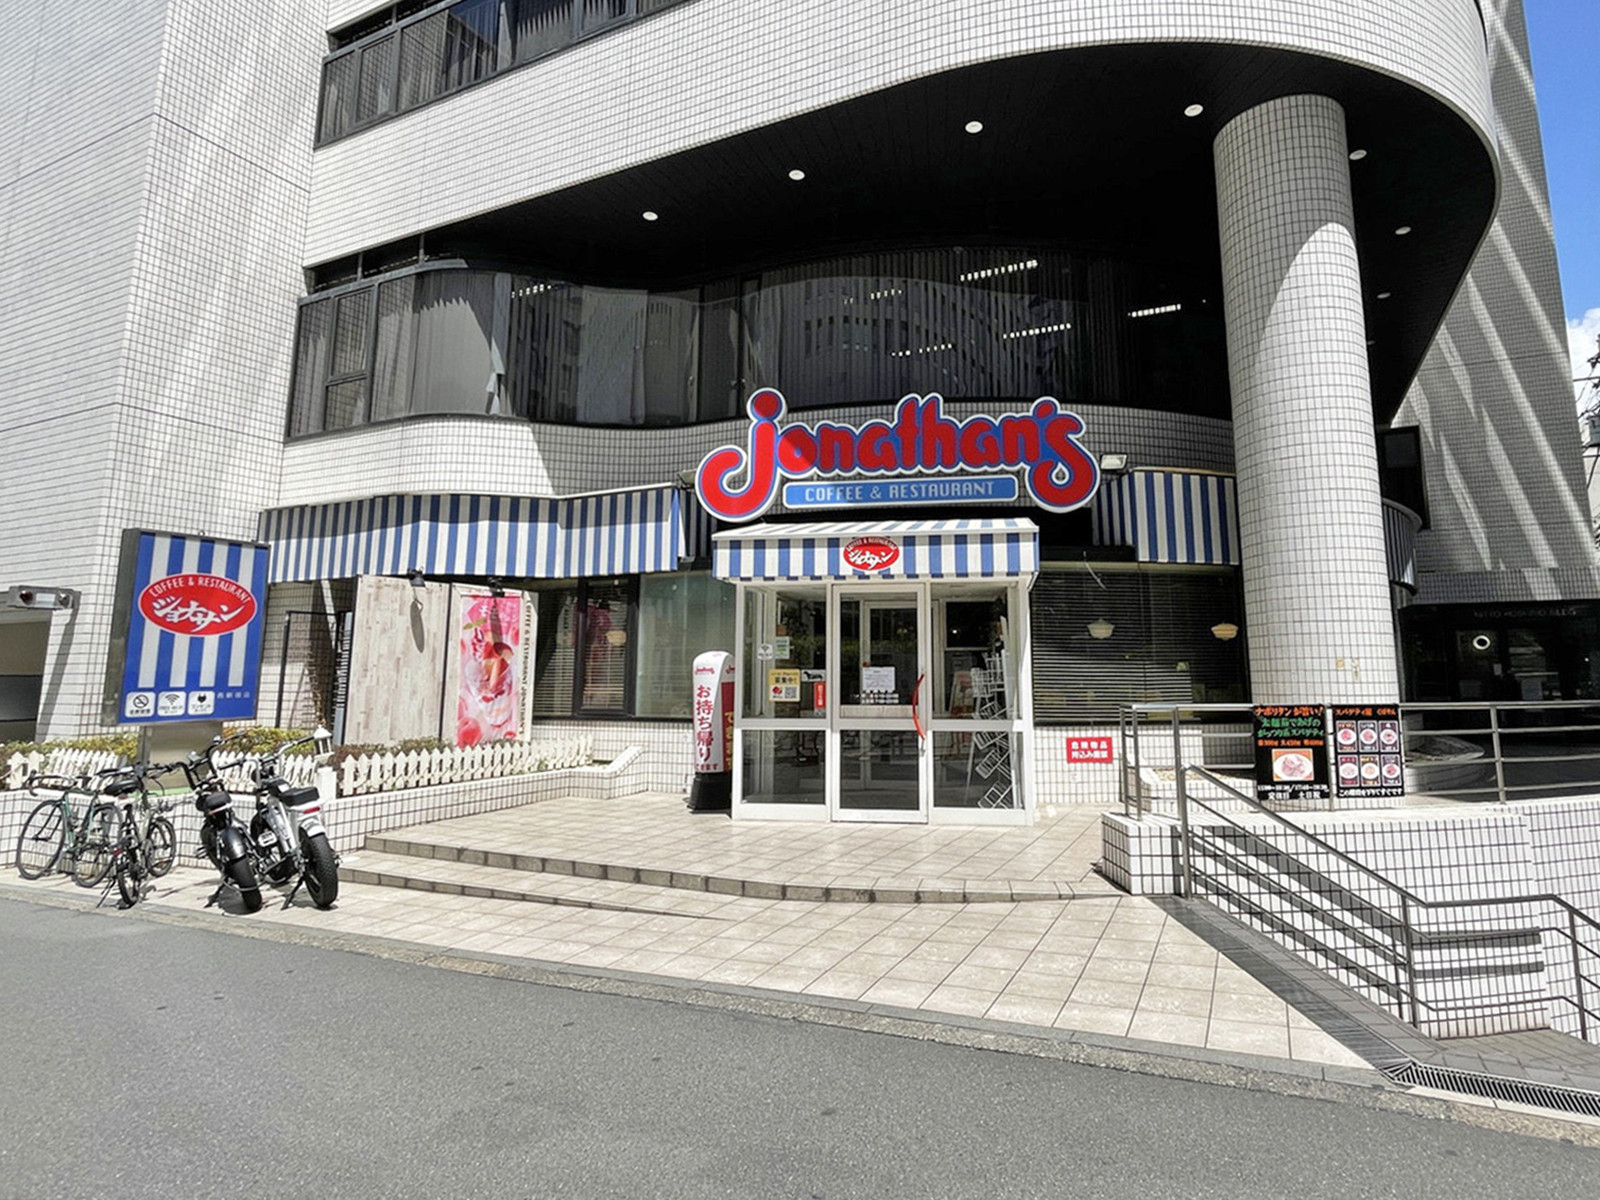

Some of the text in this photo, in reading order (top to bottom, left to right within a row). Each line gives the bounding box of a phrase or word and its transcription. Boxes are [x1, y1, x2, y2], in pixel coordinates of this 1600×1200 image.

[804, 481, 995, 502] COFFEE & RESTAURANT
[149, 576, 251, 604] COFFEE & RESTAURANT
[151, 595, 245, 633] ジョナサン
[696, 684, 714, 762] お持ち帰り
[1268, 791, 1290, 800] 定休日
